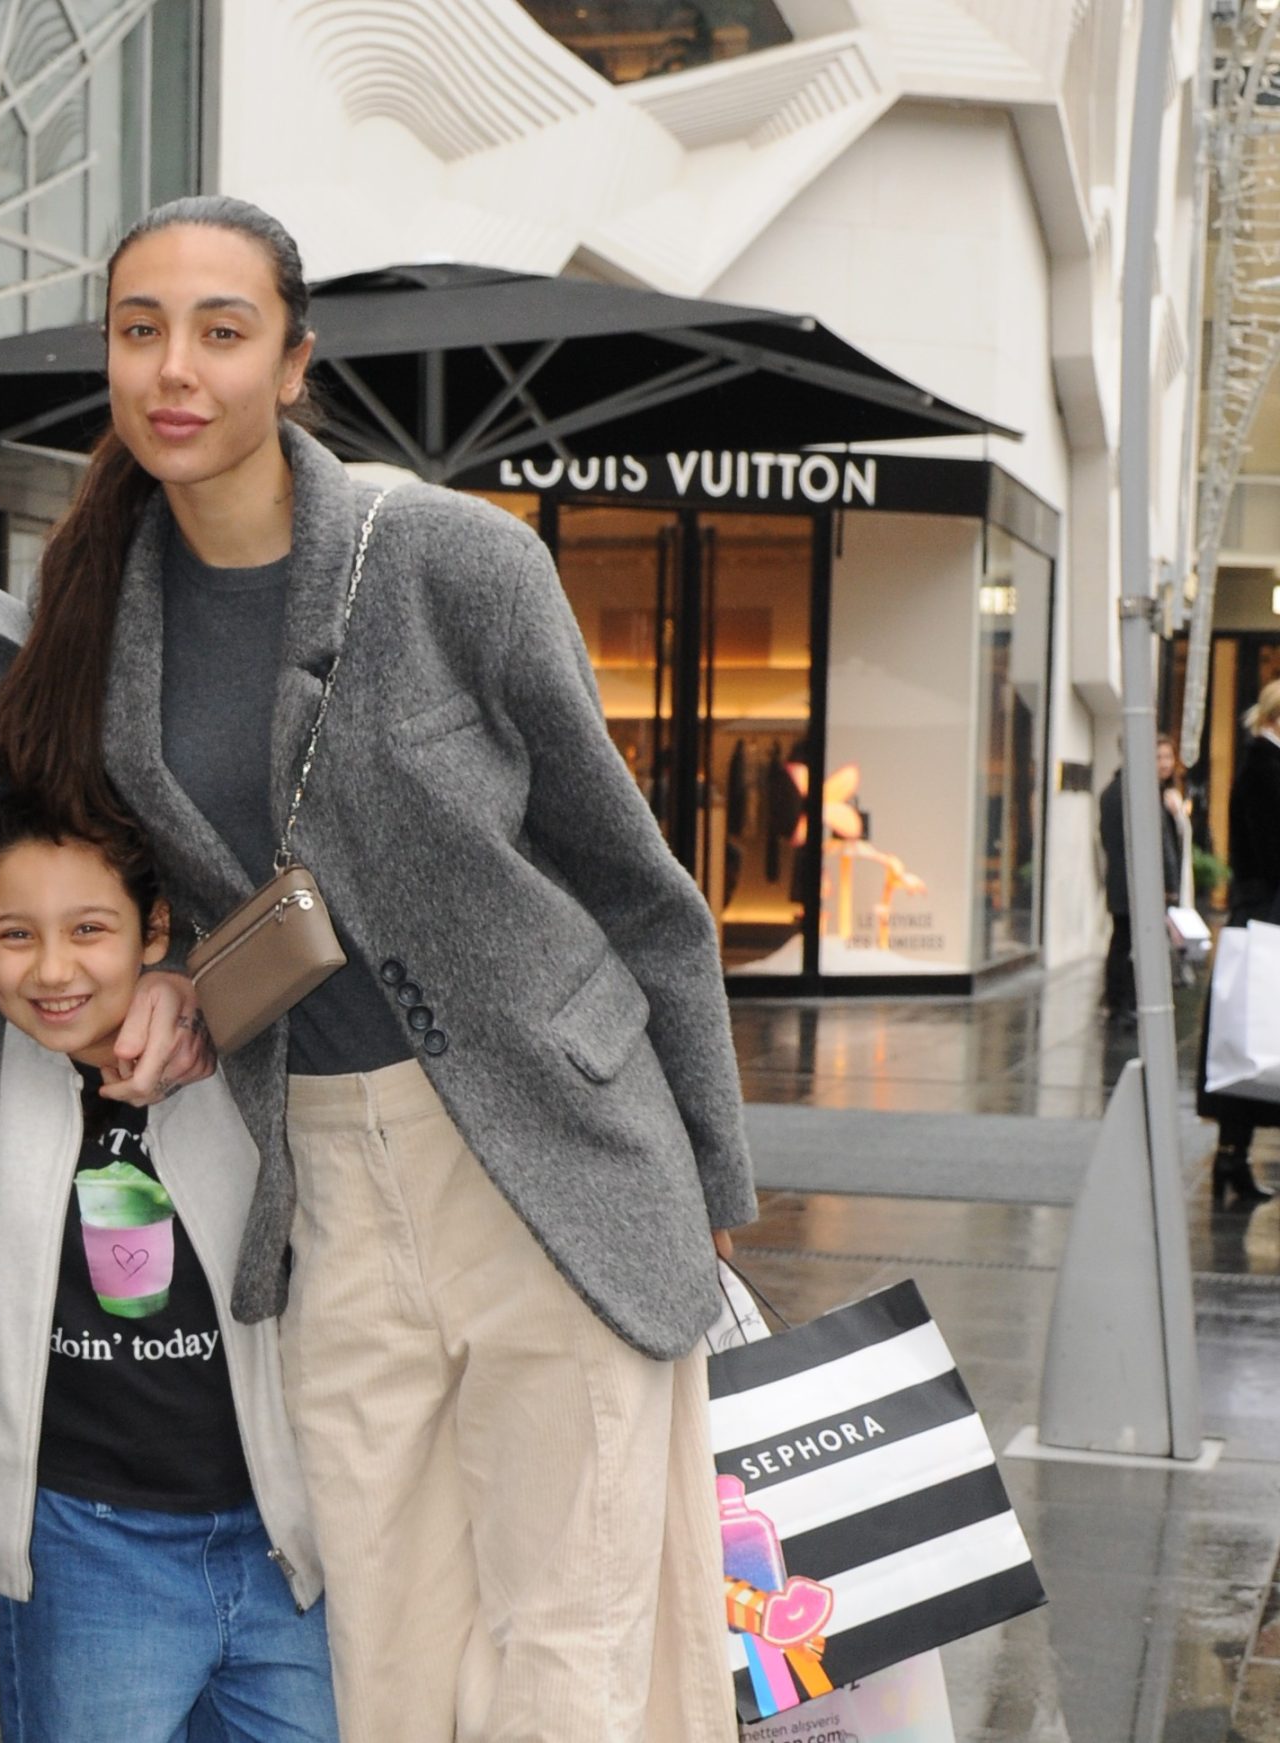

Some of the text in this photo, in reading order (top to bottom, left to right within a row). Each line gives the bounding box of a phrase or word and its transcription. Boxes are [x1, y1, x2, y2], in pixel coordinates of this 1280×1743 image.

[500, 450, 877, 505] LOUIS VUITTON
[131, 1328, 219, 1361] today
[740, 1415, 886, 1480] SEPHORA
